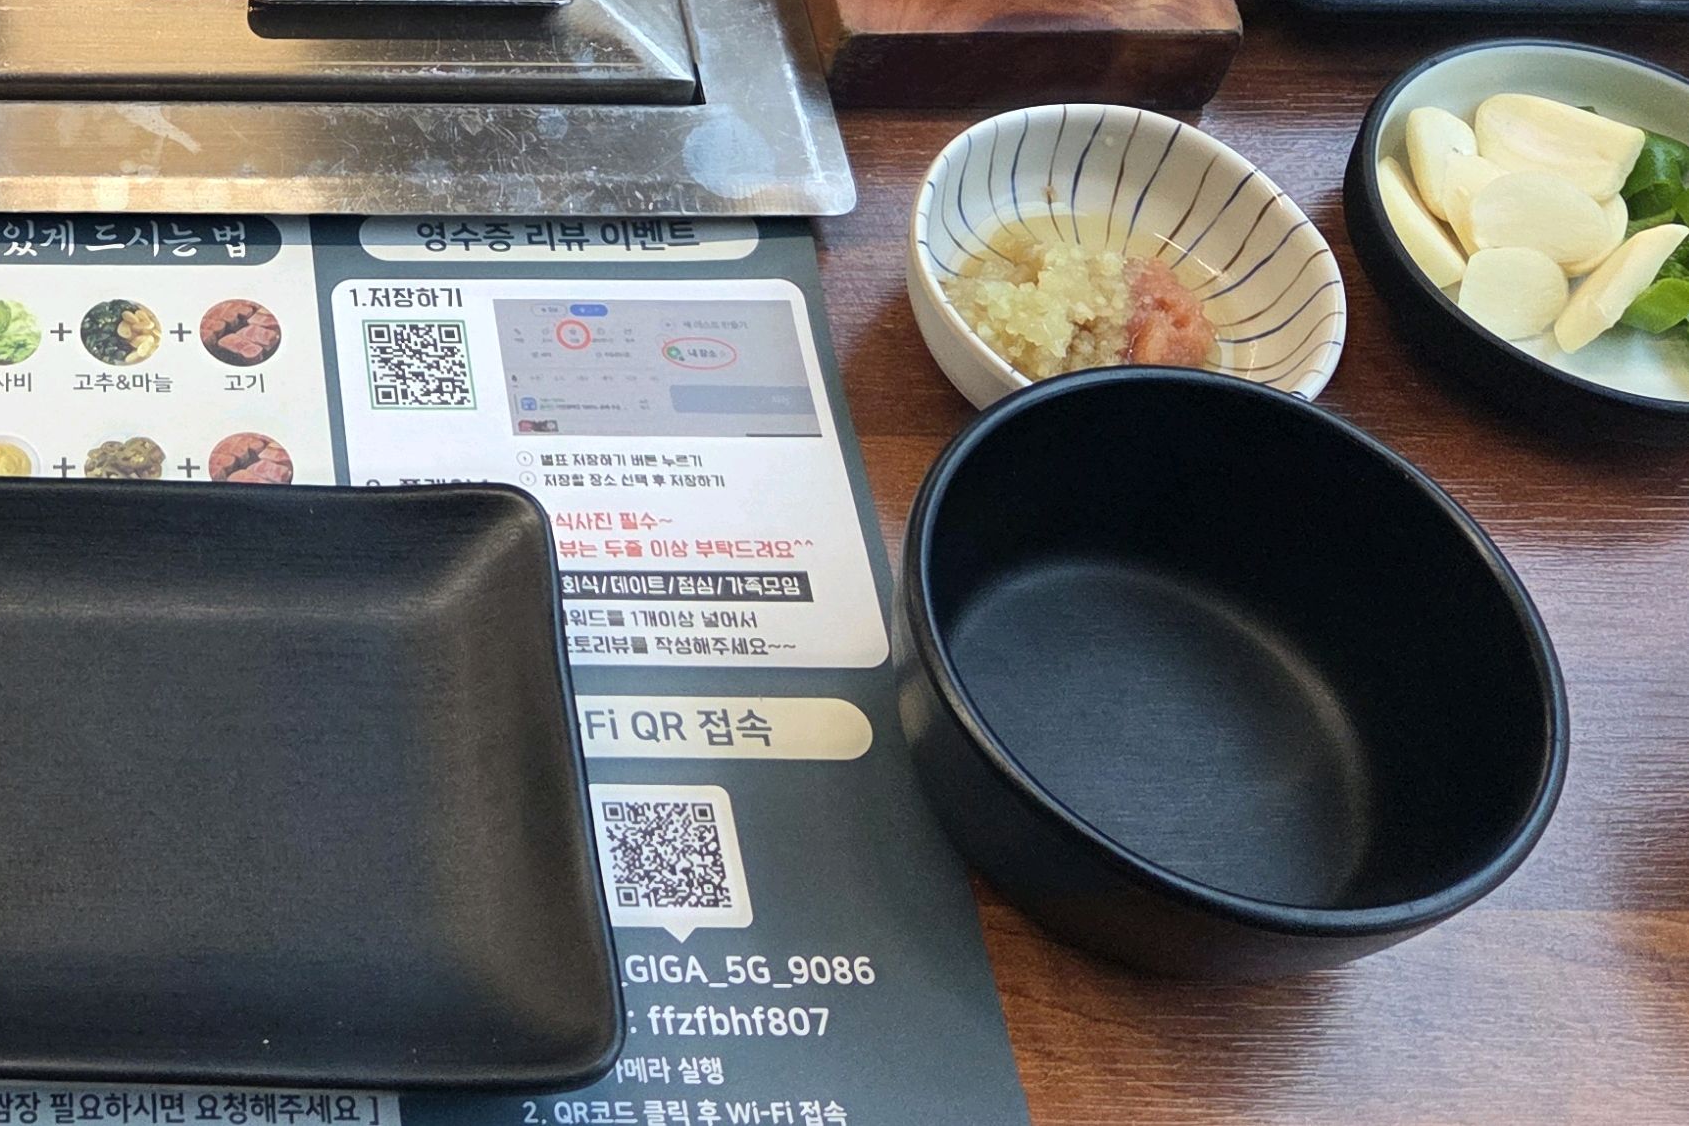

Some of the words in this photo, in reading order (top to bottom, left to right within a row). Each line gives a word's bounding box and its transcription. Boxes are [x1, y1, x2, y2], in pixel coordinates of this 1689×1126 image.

[86, 220, 201, 257] 드시는
[214, 220, 247, 259] 법
[416, 221, 515, 252] 영수증
[525, 220, 590, 251] 리뷰
[600, 220, 700, 251] 이벤트
[73, 372, 174, 394] 고추&마늘
[223, 373, 266, 394] 고기
[573, 454, 626, 467] 저장하기
[631, 454, 657, 467] 버튼
[662, 454, 703, 467] 누르기
[544, 474, 585, 487] 저장할
[590, 474, 617, 487] 장소
[622, 474, 649, 487] 선택
[652, 474, 666, 487] 후
[671, 474, 726, 487] 저장하기
[552, 512, 613, 531] 식사진
[604, 540, 643, 558] 두줄
[650, 540, 689, 558] 이상
[563, 609, 625, 627] 워드를
[630, 610, 695, 628] 1개이상
[579, 708, 618, 740] Fi
[631, 710, 687, 743] QR
[696, 708, 772, 747] 접속
[647, 1005, 829, 1036] ffzfbhf807
[678, 1056, 725, 1085] 실행
[50, 1092, 186, 1125] 필요하시면
[195, 1092, 360, 1125] 요청해주세요
[522, 1101, 547, 1125] 2.
[554, 1100, 638, 1125] QR코드
[643, 1100, 689, 1126] 클릭
[696, 1100, 721, 1125] 후
[725, 1100, 794, 1125] Wi-Fi
[799, 1100, 848, 1126] 접속
